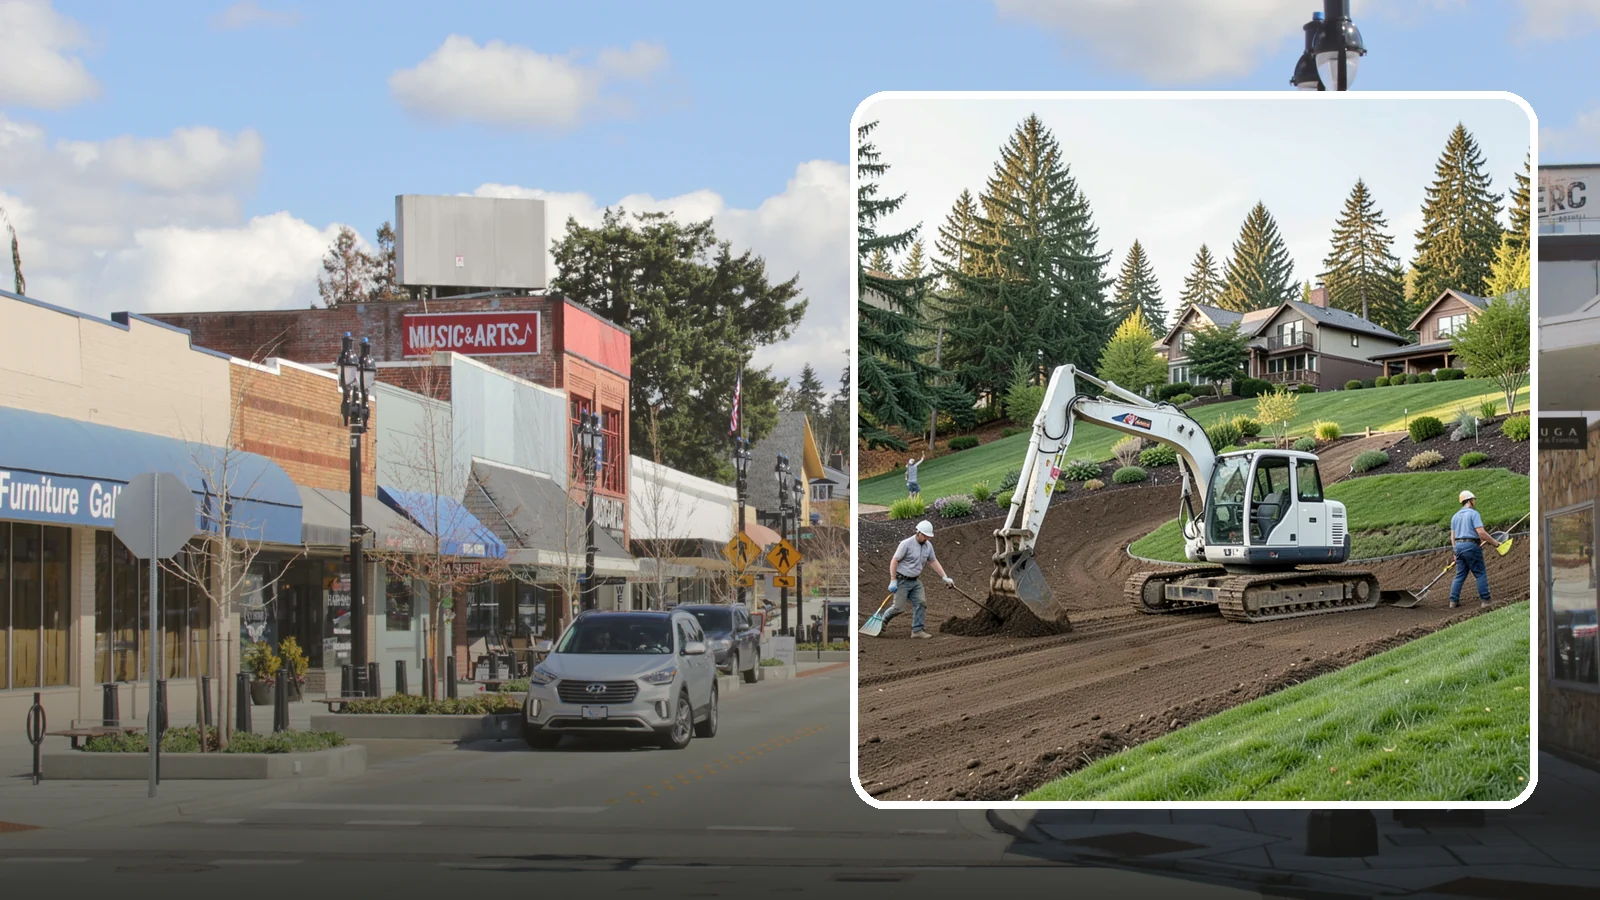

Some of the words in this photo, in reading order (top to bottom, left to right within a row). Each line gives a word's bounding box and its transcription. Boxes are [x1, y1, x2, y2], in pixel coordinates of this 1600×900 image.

[409, 323, 520, 349] MUSIC&ARTS
[0, 471, 79, 515] Furniture
[89, 482, 122, 519] Gal
[452, 563, 480, 574] SUSHI
